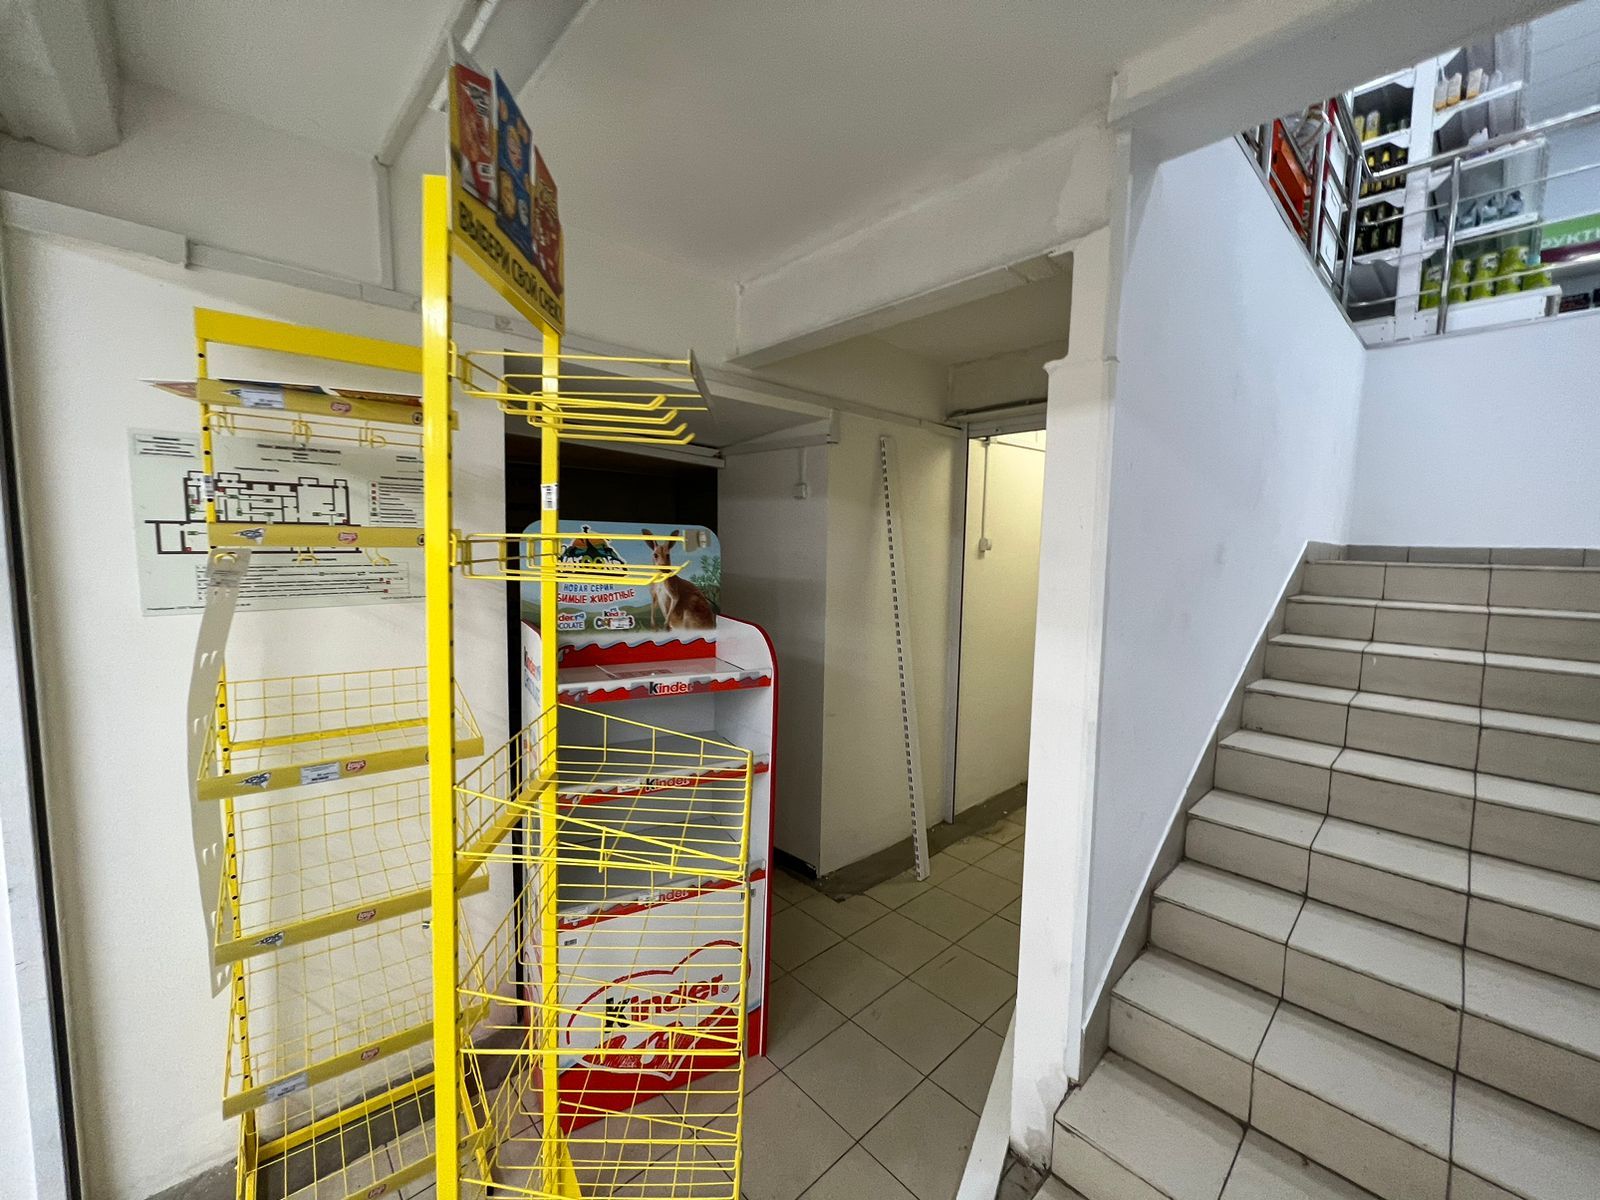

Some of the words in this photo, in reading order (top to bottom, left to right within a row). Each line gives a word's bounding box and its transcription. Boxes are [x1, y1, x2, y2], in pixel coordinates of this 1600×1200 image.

[459, 202, 511, 274] ВЫБЕРИ
[511, 259, 538, 298] СВОЙ
[563, 584, 588, 592] НОВАЯ
[590, 584, 614, 592] СЕРИЯ
[589, 588, 635, 603] ЖИВОТНЫЕ
[649, 682, 692, 694] Kinder
[646, 777, 689, 791] Kinder
[605, 974, 723, 1033] Kinder
